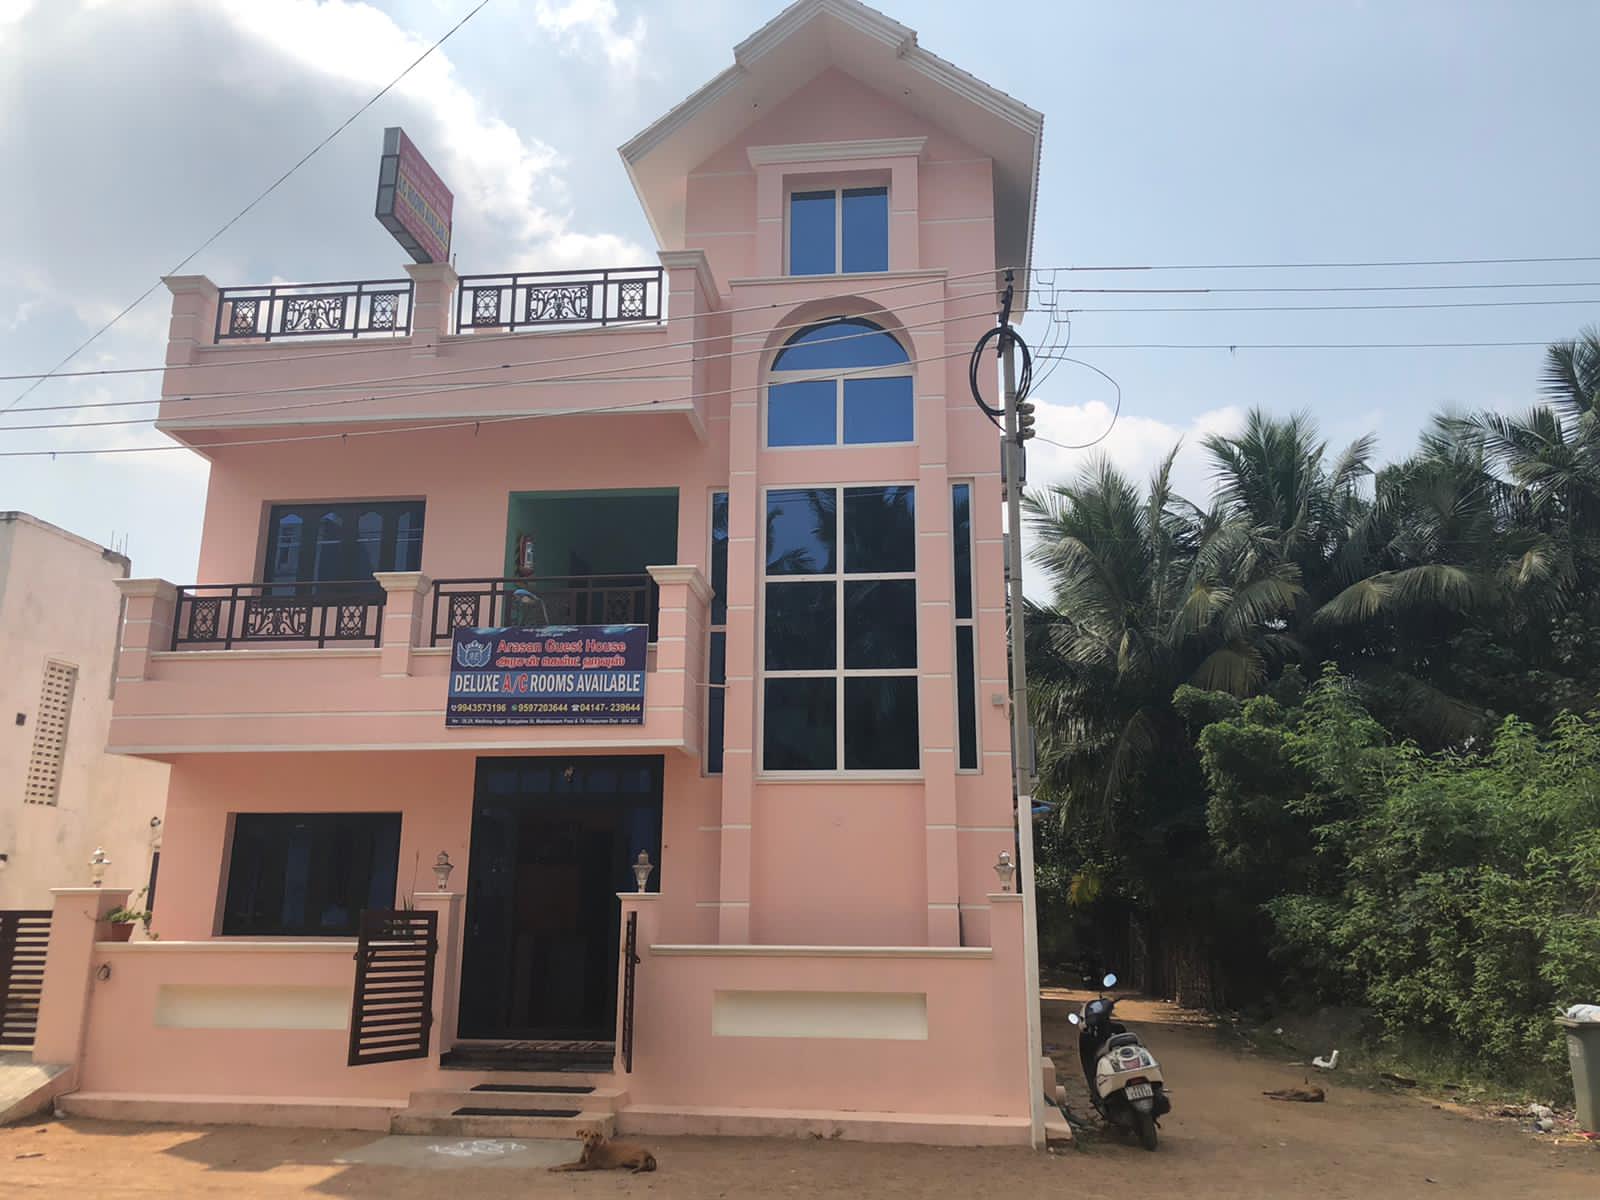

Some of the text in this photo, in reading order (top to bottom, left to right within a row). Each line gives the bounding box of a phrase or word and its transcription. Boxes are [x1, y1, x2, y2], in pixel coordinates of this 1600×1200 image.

[496, 639, 626, 653] Arasan Guest House
[454, 673, 641, 694] DELUXE A/C ROOMS AVAILABLE
